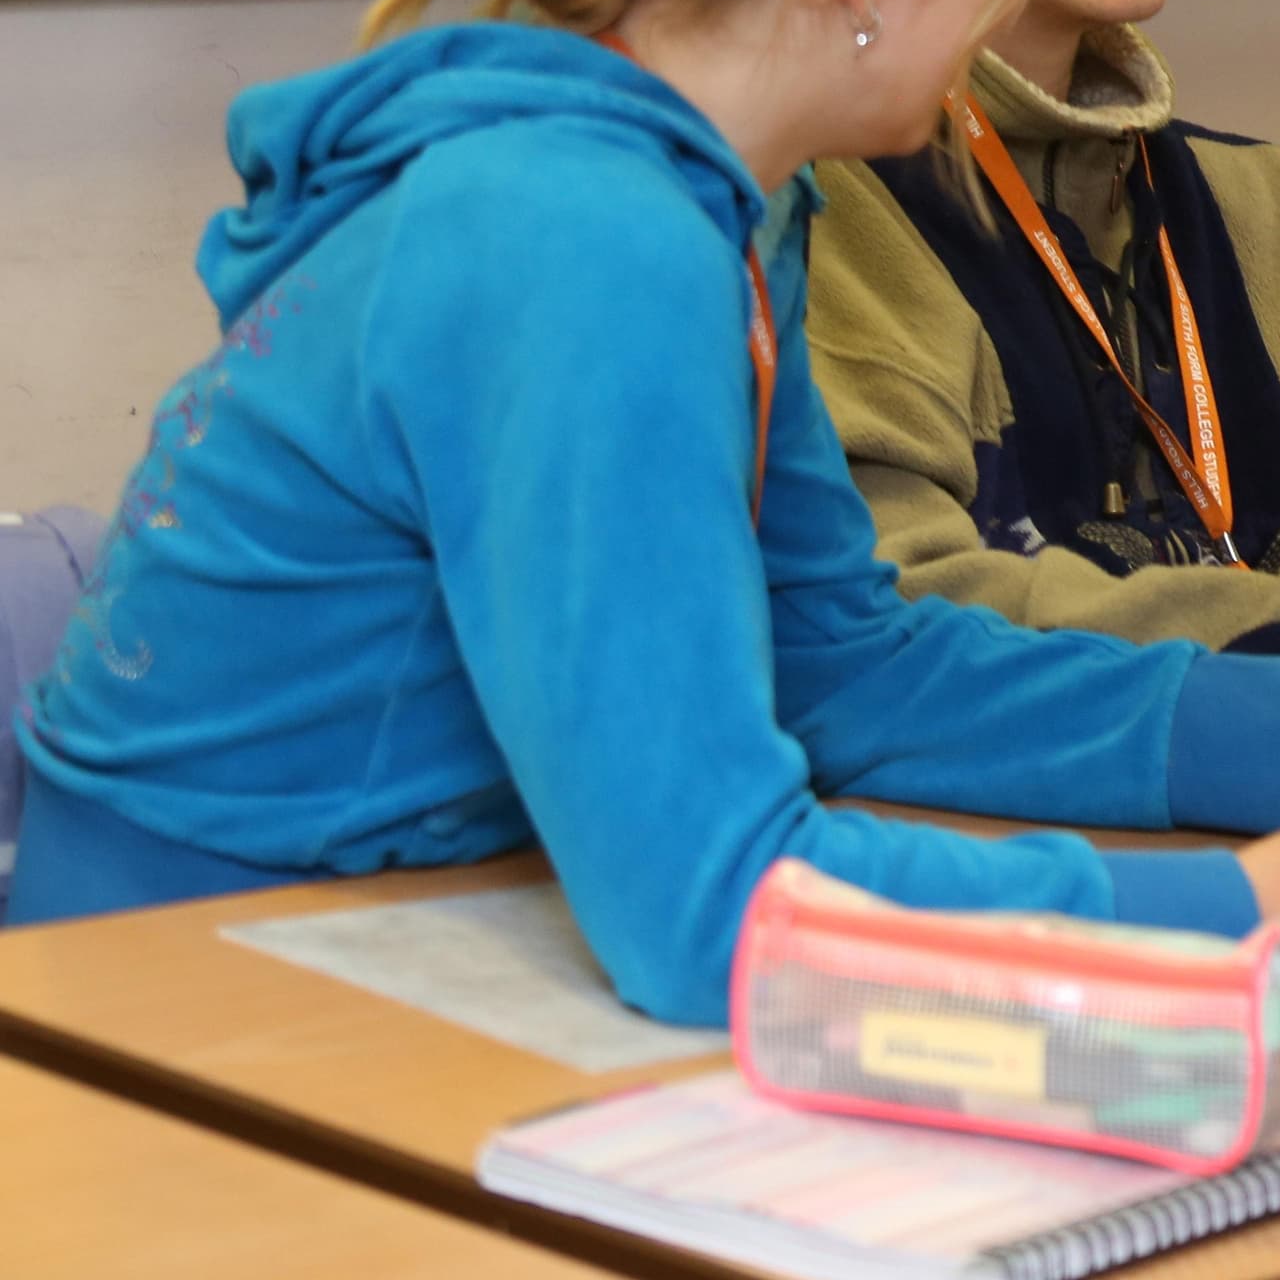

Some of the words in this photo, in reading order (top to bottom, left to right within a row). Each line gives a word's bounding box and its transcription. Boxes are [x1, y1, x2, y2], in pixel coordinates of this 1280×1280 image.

[1180, 302, 1195, 343] SIXTH
[1186, 344, 1204, 382] FORM
[1193, 383, 1215, 450] COLLEGE
[1183, 469, 1209, 510] HILLS
